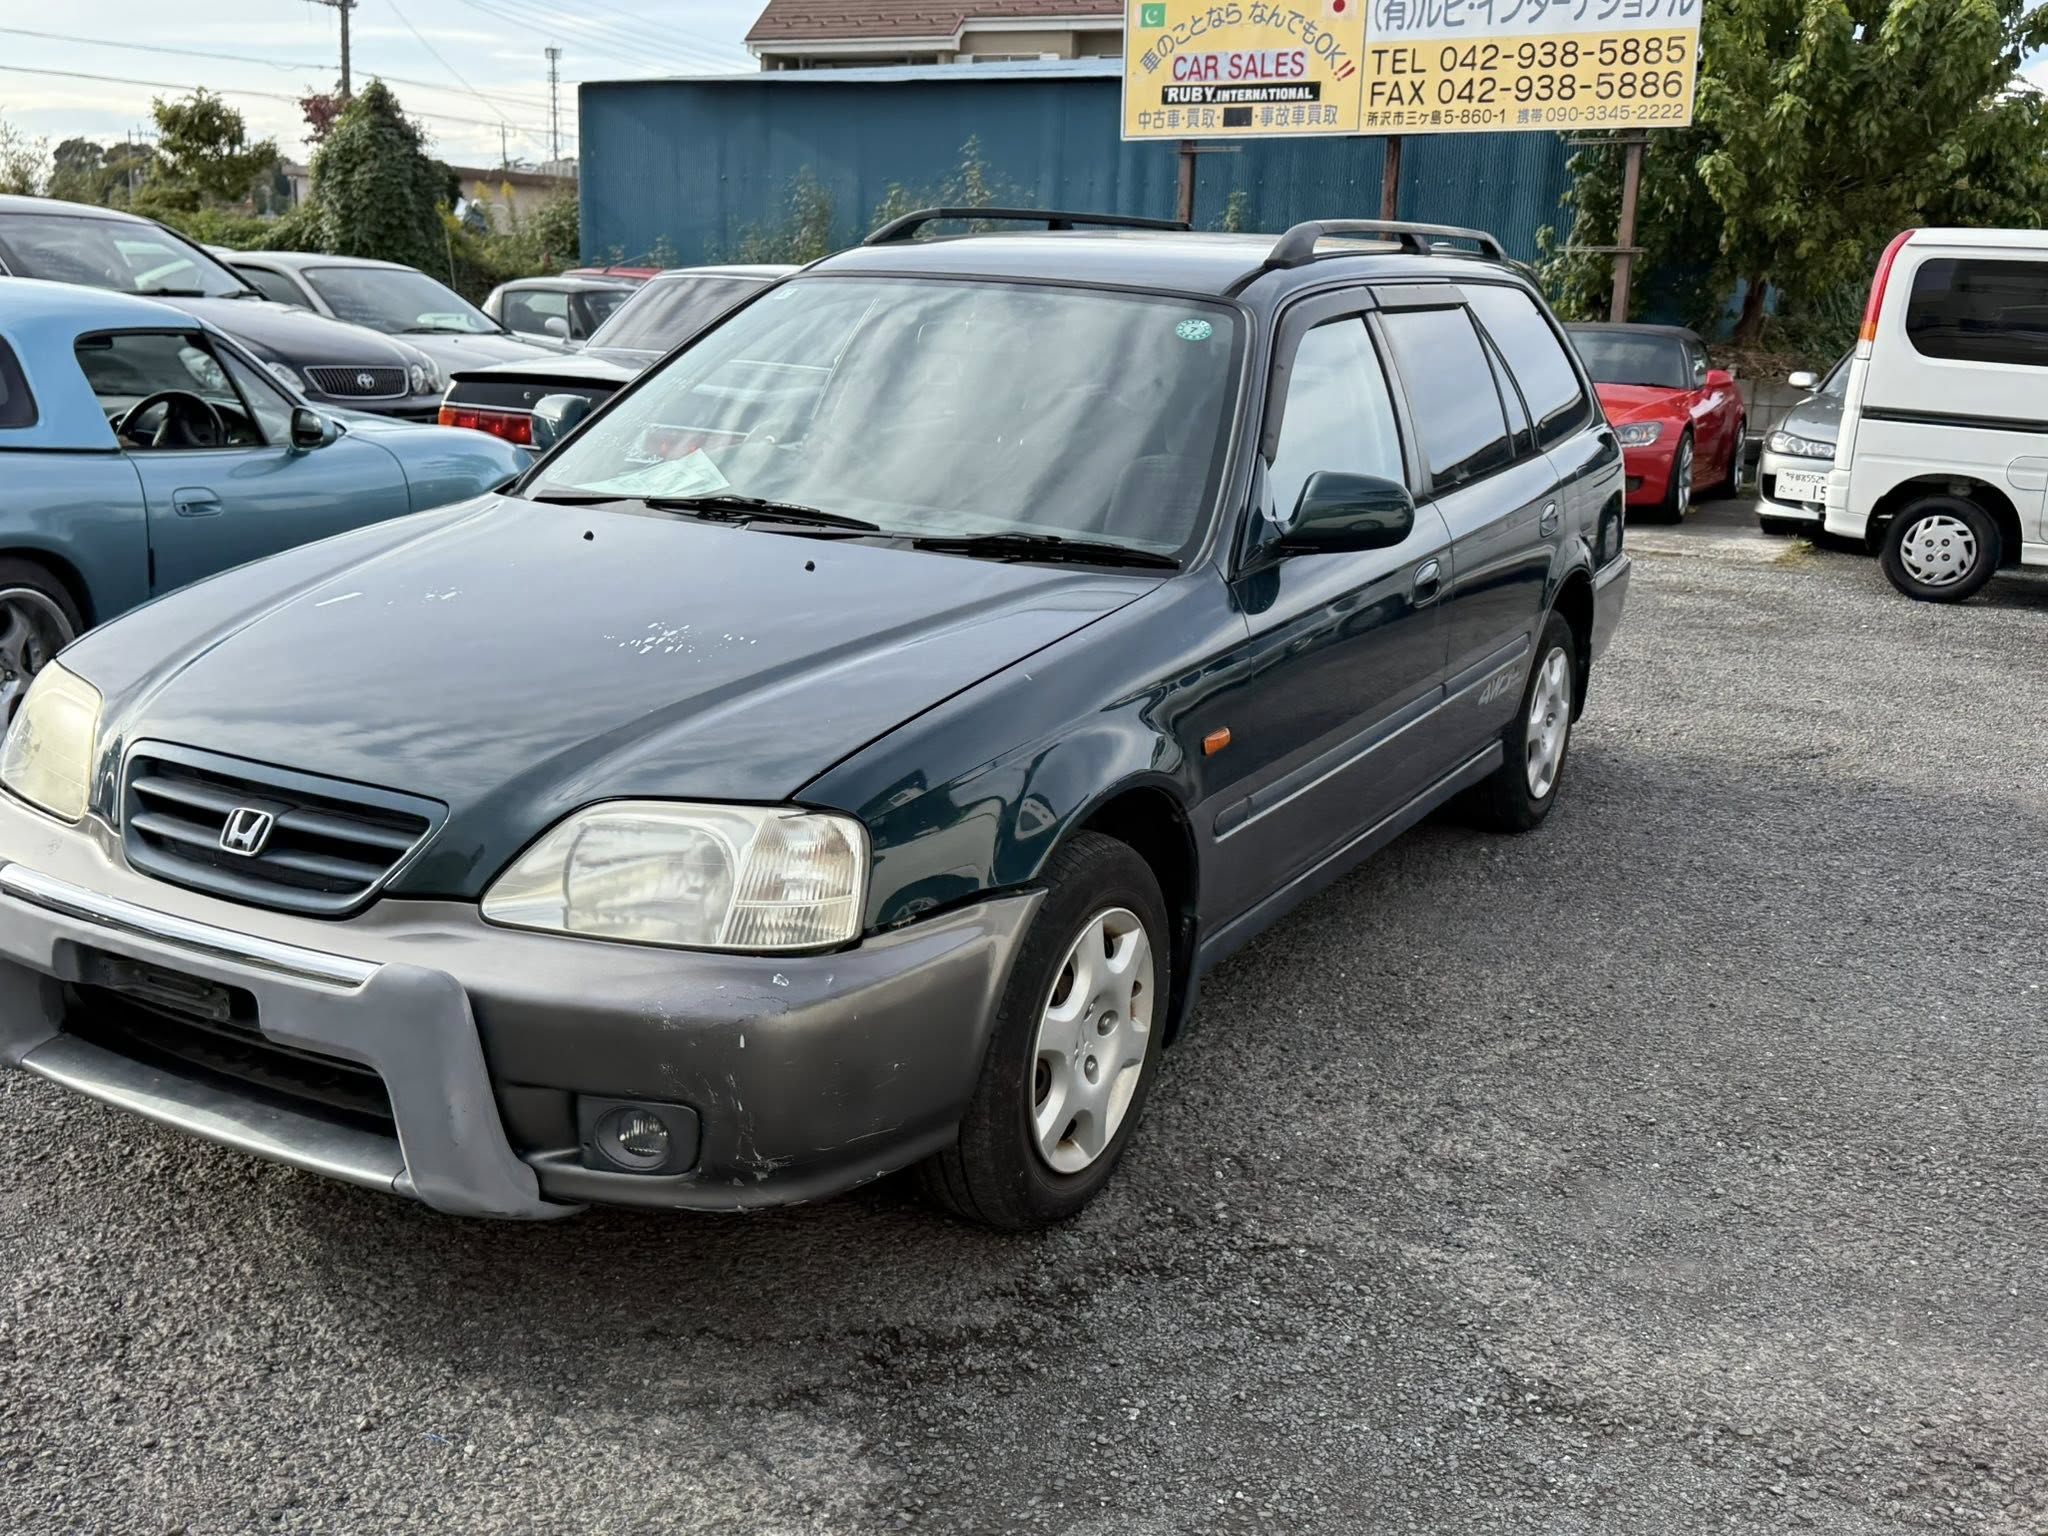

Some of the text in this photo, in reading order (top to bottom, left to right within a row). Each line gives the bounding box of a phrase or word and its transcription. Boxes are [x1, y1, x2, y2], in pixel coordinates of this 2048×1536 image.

[1139, 3, 1242, 74] 車のことなら
[1371, 36, 1686, 75] TEL 042-938-5885
[1173, 51, 1305, 81] CAR SALES
[1370, 70, 1683, 107] FAX 042-938-5886
